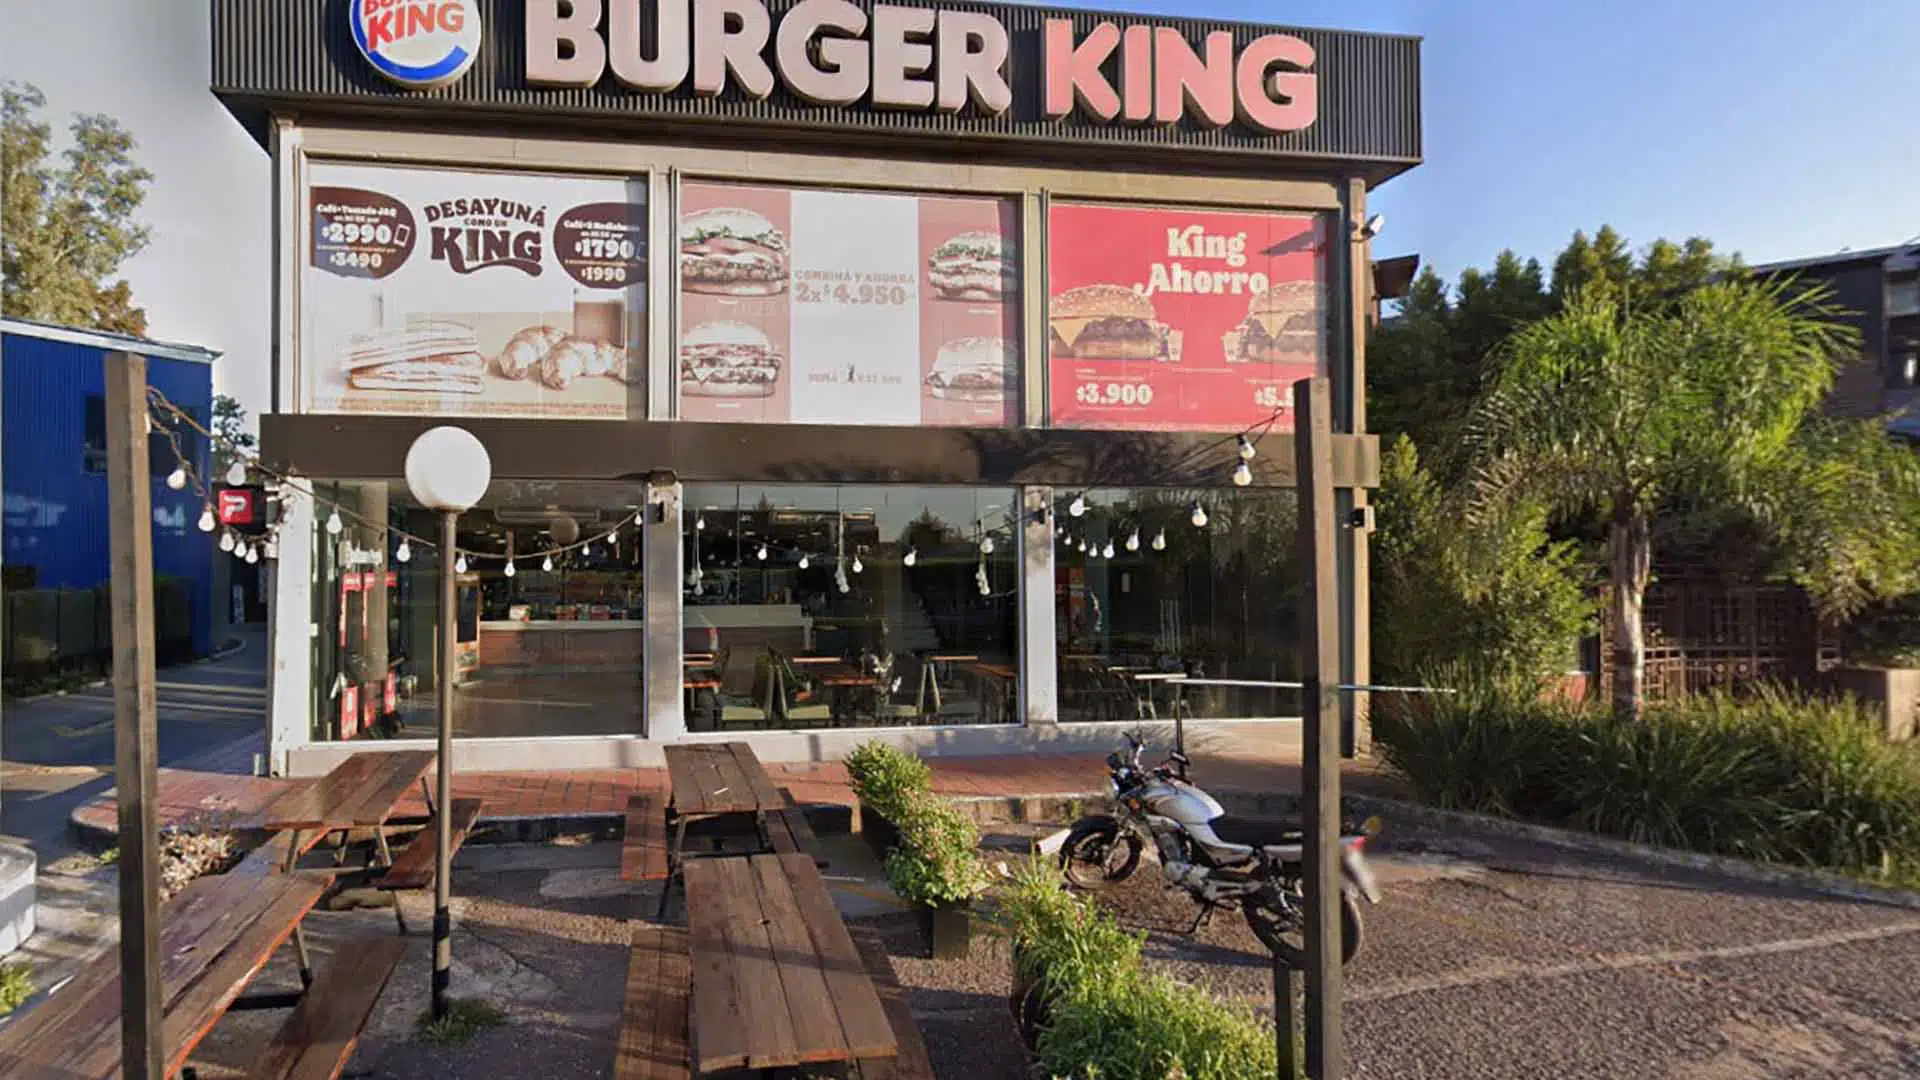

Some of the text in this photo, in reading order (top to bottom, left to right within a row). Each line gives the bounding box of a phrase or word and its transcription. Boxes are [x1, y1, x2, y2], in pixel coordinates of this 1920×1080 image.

[368, 2, 465, 50] KING
[526, 0, 1319, 132] BURGER KING
[424, 197, 547, 228] DESAYUNÁ
[431, 227, 543, 277] KING
[1167, 224, 1248, 267] King
[1132, 262, 1270, 297] Ahorro
[1075, 383, 1153, 406] $3.900
